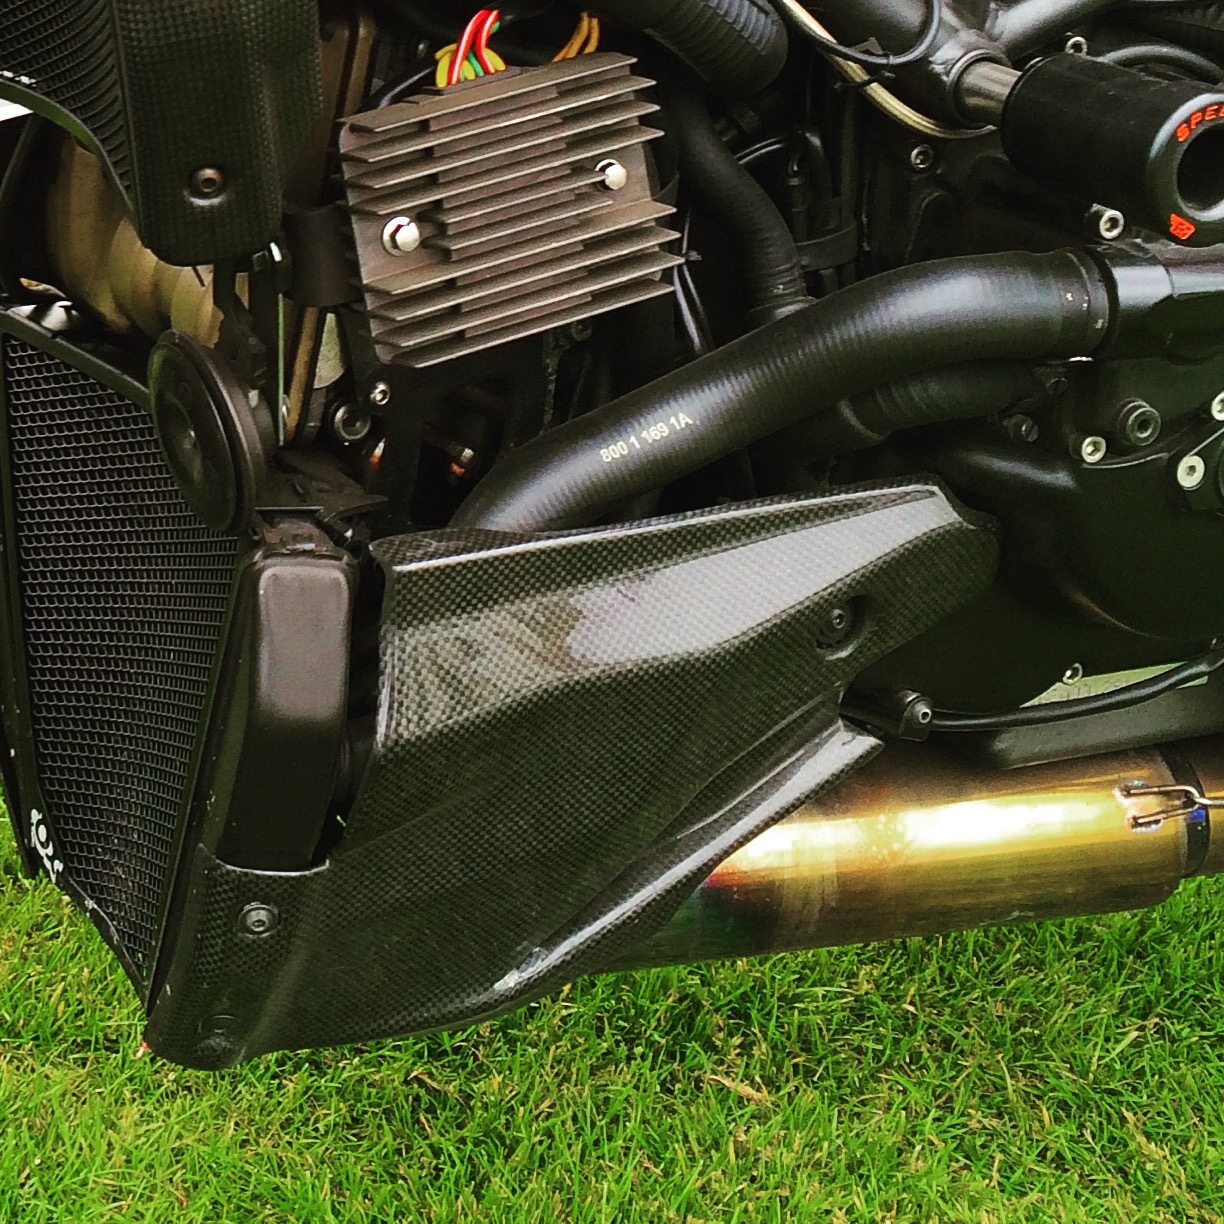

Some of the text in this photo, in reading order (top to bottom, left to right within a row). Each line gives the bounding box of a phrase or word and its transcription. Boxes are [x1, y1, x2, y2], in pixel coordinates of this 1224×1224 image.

[599, 412, 694, 463] 800 1 169 1A
